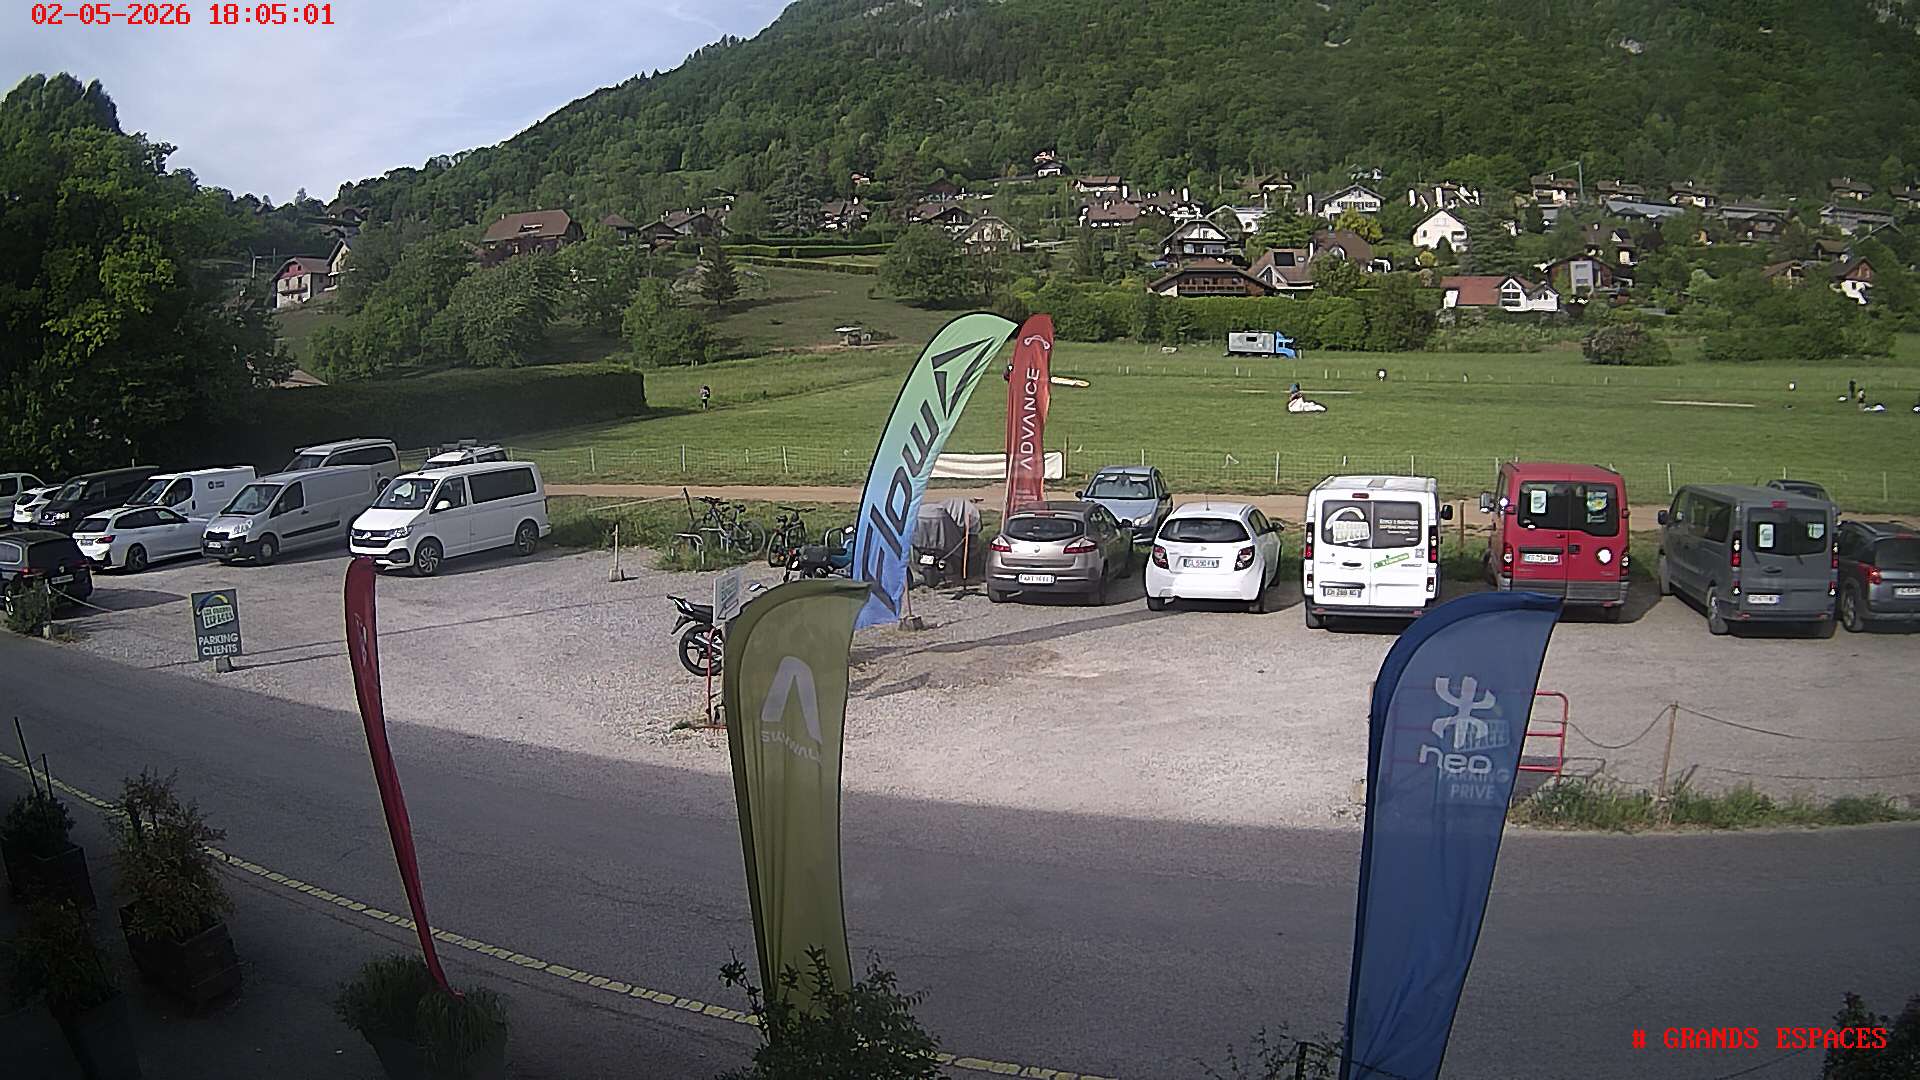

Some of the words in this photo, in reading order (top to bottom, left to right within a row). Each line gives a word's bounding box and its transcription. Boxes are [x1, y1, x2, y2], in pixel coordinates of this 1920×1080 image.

[1019, 367, 1040, 471] ADVANCE
[198, 633, 238, 646] PARKING
[202, 643, 238, 656] CLIENTS
[1419, 744, 1493, 774] neo
[1451, 784, 1495, 800] PRIVE
